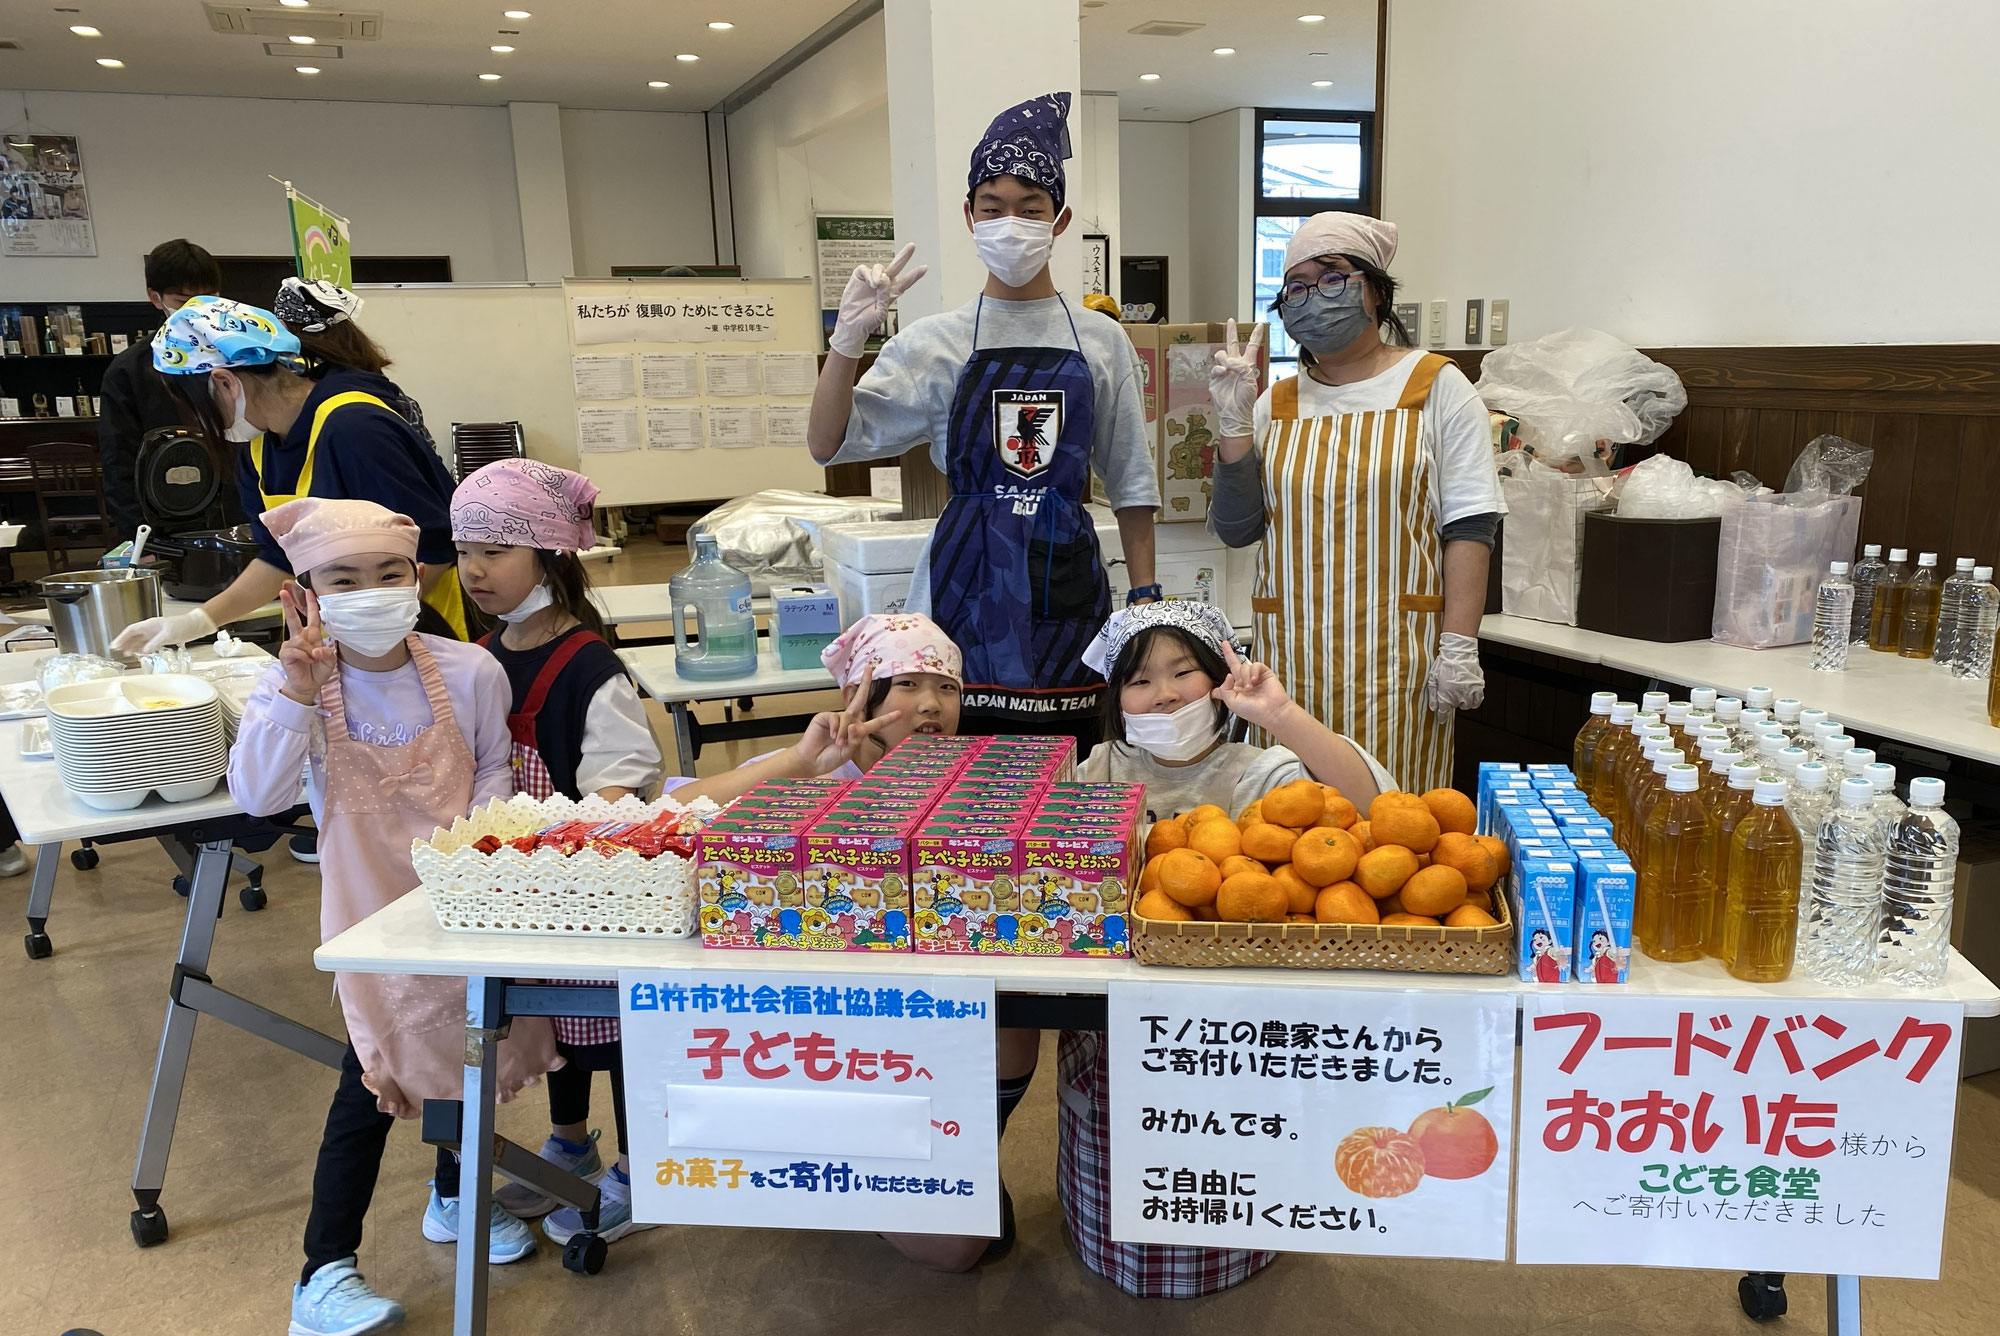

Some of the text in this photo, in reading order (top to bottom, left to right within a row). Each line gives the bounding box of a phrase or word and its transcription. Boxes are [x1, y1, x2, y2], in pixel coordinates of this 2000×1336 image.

[577, 303, 630, 319] 私たちが
[636, 303, 676, 319] 復興の
[1010, 393, 1047, 402] JAPAN
[1014, 450, 1042, 465] JFA
[784, 603, 834, 613] ラテックス M
[1060, 693, 1097, 711] TEAM
[731, 835, 764, 845] ギンビス
[838, 837, 870, 846] ギンビス
[948, 839, 981, 847] ギンビス
[1056, 840, 1090, 849] ギンビス
[702, 845, 795, 864] たべっ子どうぶつ
[808, 847, 902, 866] たべっ子どうぶつ
[917, 850, 1013, 869] たべっ子どうぶつ
[1025, 851, 1122, 870] たべっ子どうぶつ
[704, 934, 760, 947] ギンビス
[763, 934, 847, 950] たべっ子どうぶつ
[918, 940, 974, 953] ギンビス
[978, 939, 1065, 955] たべっ子どうぶつ
[630, 982, 986, 1020] 臼杵市社会福祉協議会様より
[1139, 1015, 1443, 1054] 下ノ江の農家さんから
[686, 1028, 934, 1082] 子どもたちへ
[1533, 1011, 1953, 1084] フードバンク
[1140, 1046, 1453, 1086] ご寄付いただきました。
[1141, 1106, 1300, 1141] みかんです。
[655, 1157, 975, 1197] お菓子をご寄付いただきました
[1142, 1166, 1257, 1197] ご自由に
[1637, 1163, 1821, 1201] こども食堂
[1142, 1196, 1388, 1235] お持帰りください。
[1572, 1193, 1886, 1228] へご寄付いただきました
